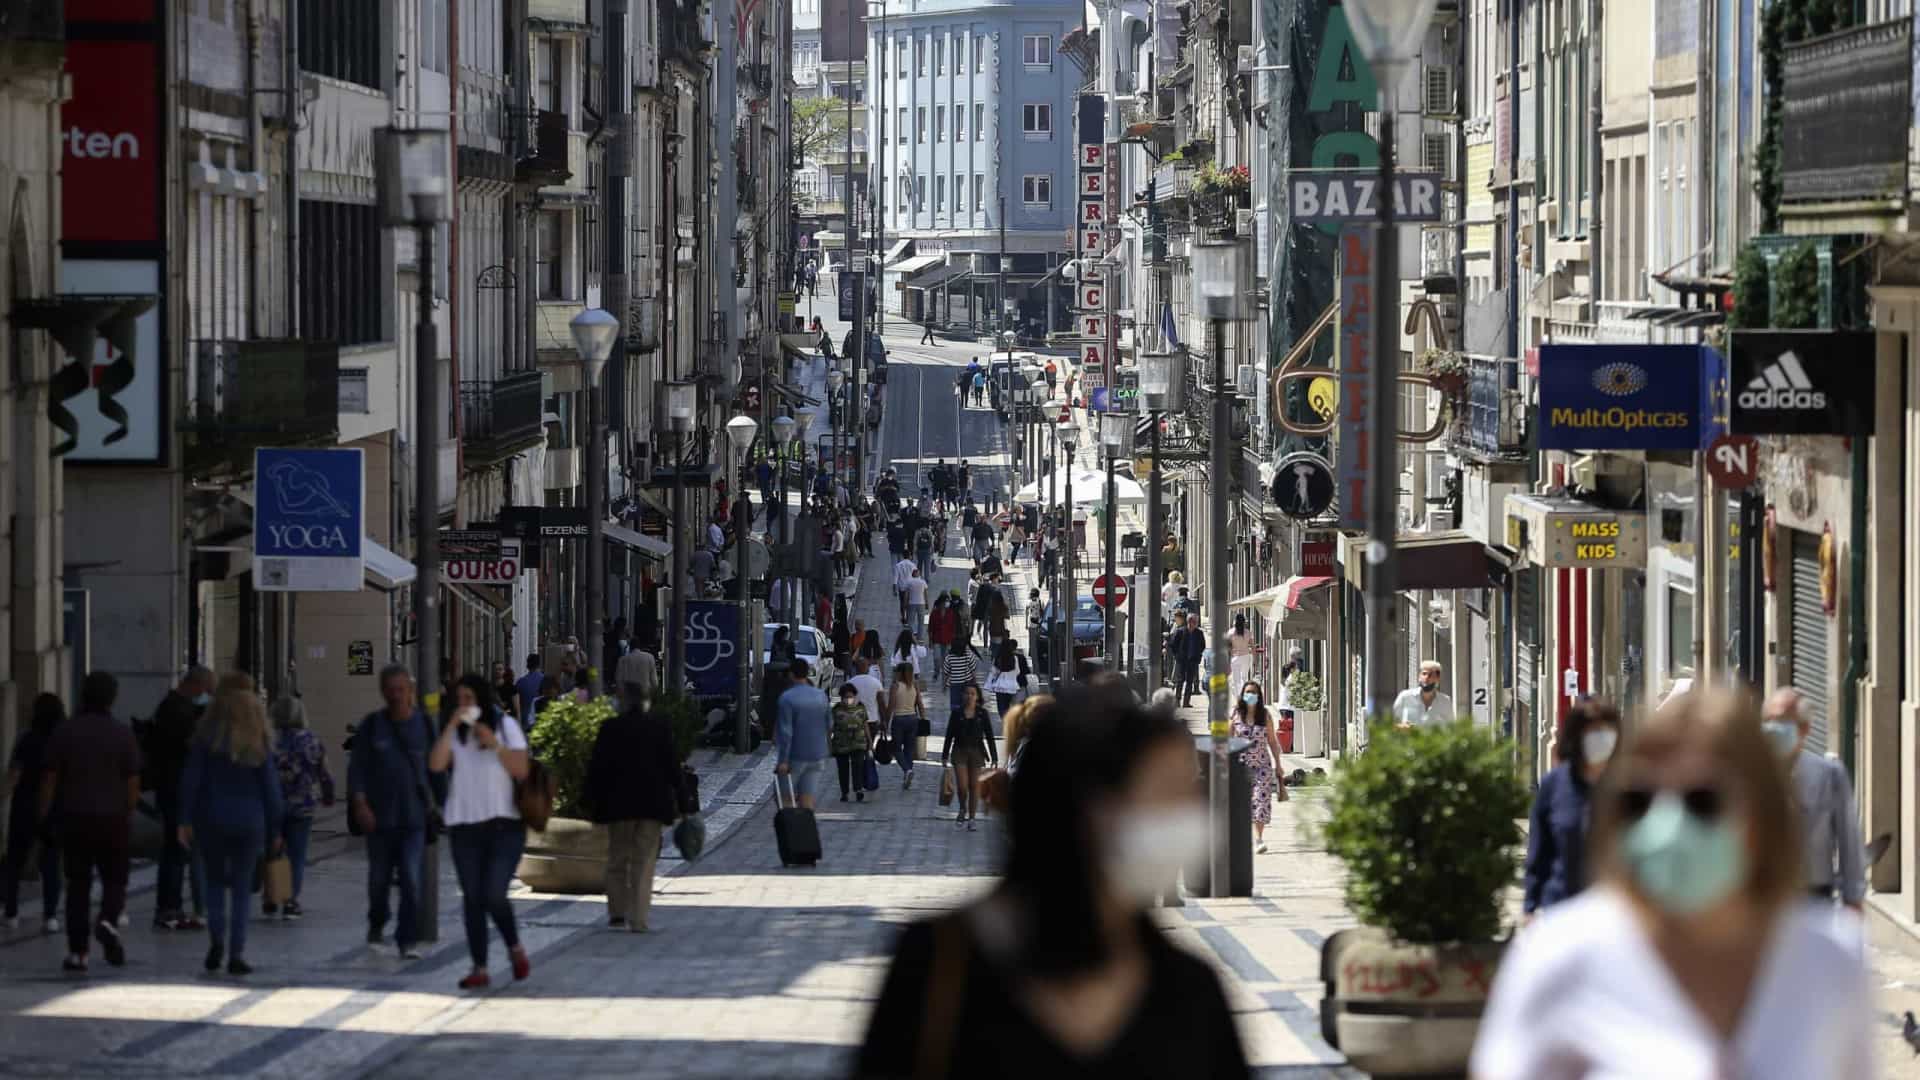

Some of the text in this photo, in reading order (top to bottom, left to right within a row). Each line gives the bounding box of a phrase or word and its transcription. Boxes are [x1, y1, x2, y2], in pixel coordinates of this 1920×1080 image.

[1738, 388, 1826, 409] adidas
[1551, 407, 1688, 432] MultiOpticas
[268, 525, 348, 549] YOGA
[1571, 523, 1620, 537] MASS
[1576, 544, 1617, 559] KIDS
[447, 560, 516, 580] OURO
